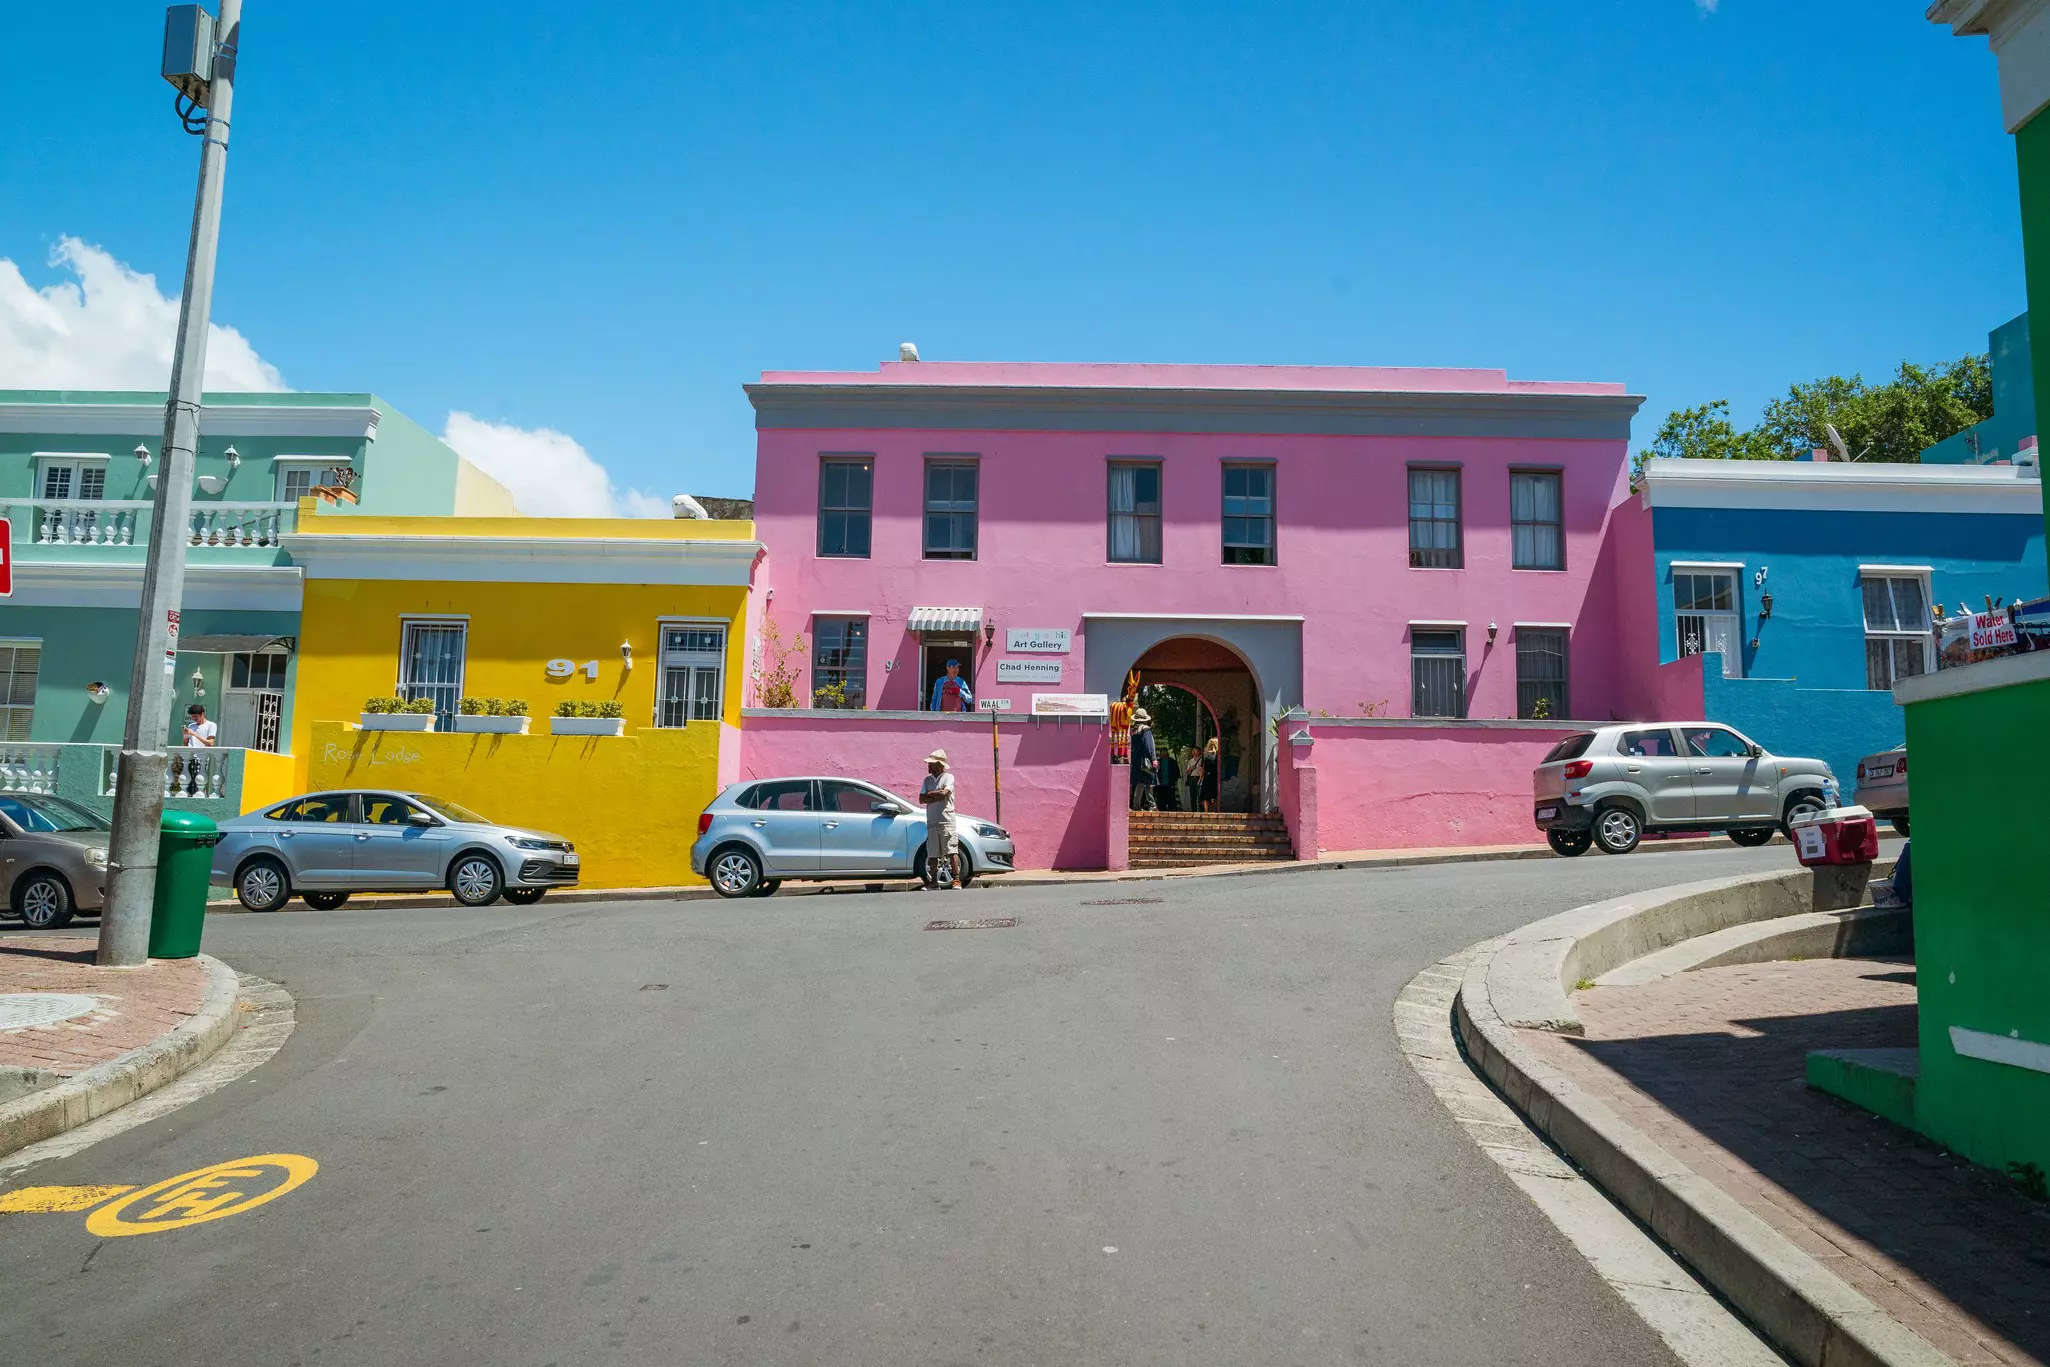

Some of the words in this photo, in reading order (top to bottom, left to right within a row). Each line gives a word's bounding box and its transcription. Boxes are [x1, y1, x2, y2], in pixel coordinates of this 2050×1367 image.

[1755, 566, 1768, 585] 97
[1975, 614, 2004, 629] Water
[1030, 641, 1062, 650] Gallery
[1973, 632, 1993, 647] Sold
[1995, 629, 2014, 644] Here
[546, 658, 599, 678] 91
[886, 659, 901, 672] 93
[999, 663, 1021, 671] Chad
[1024, 663, 1060, 672] Henning
[980, 700, 1000, 708] WAAL
[371, 744, 420, 765] Lodge
